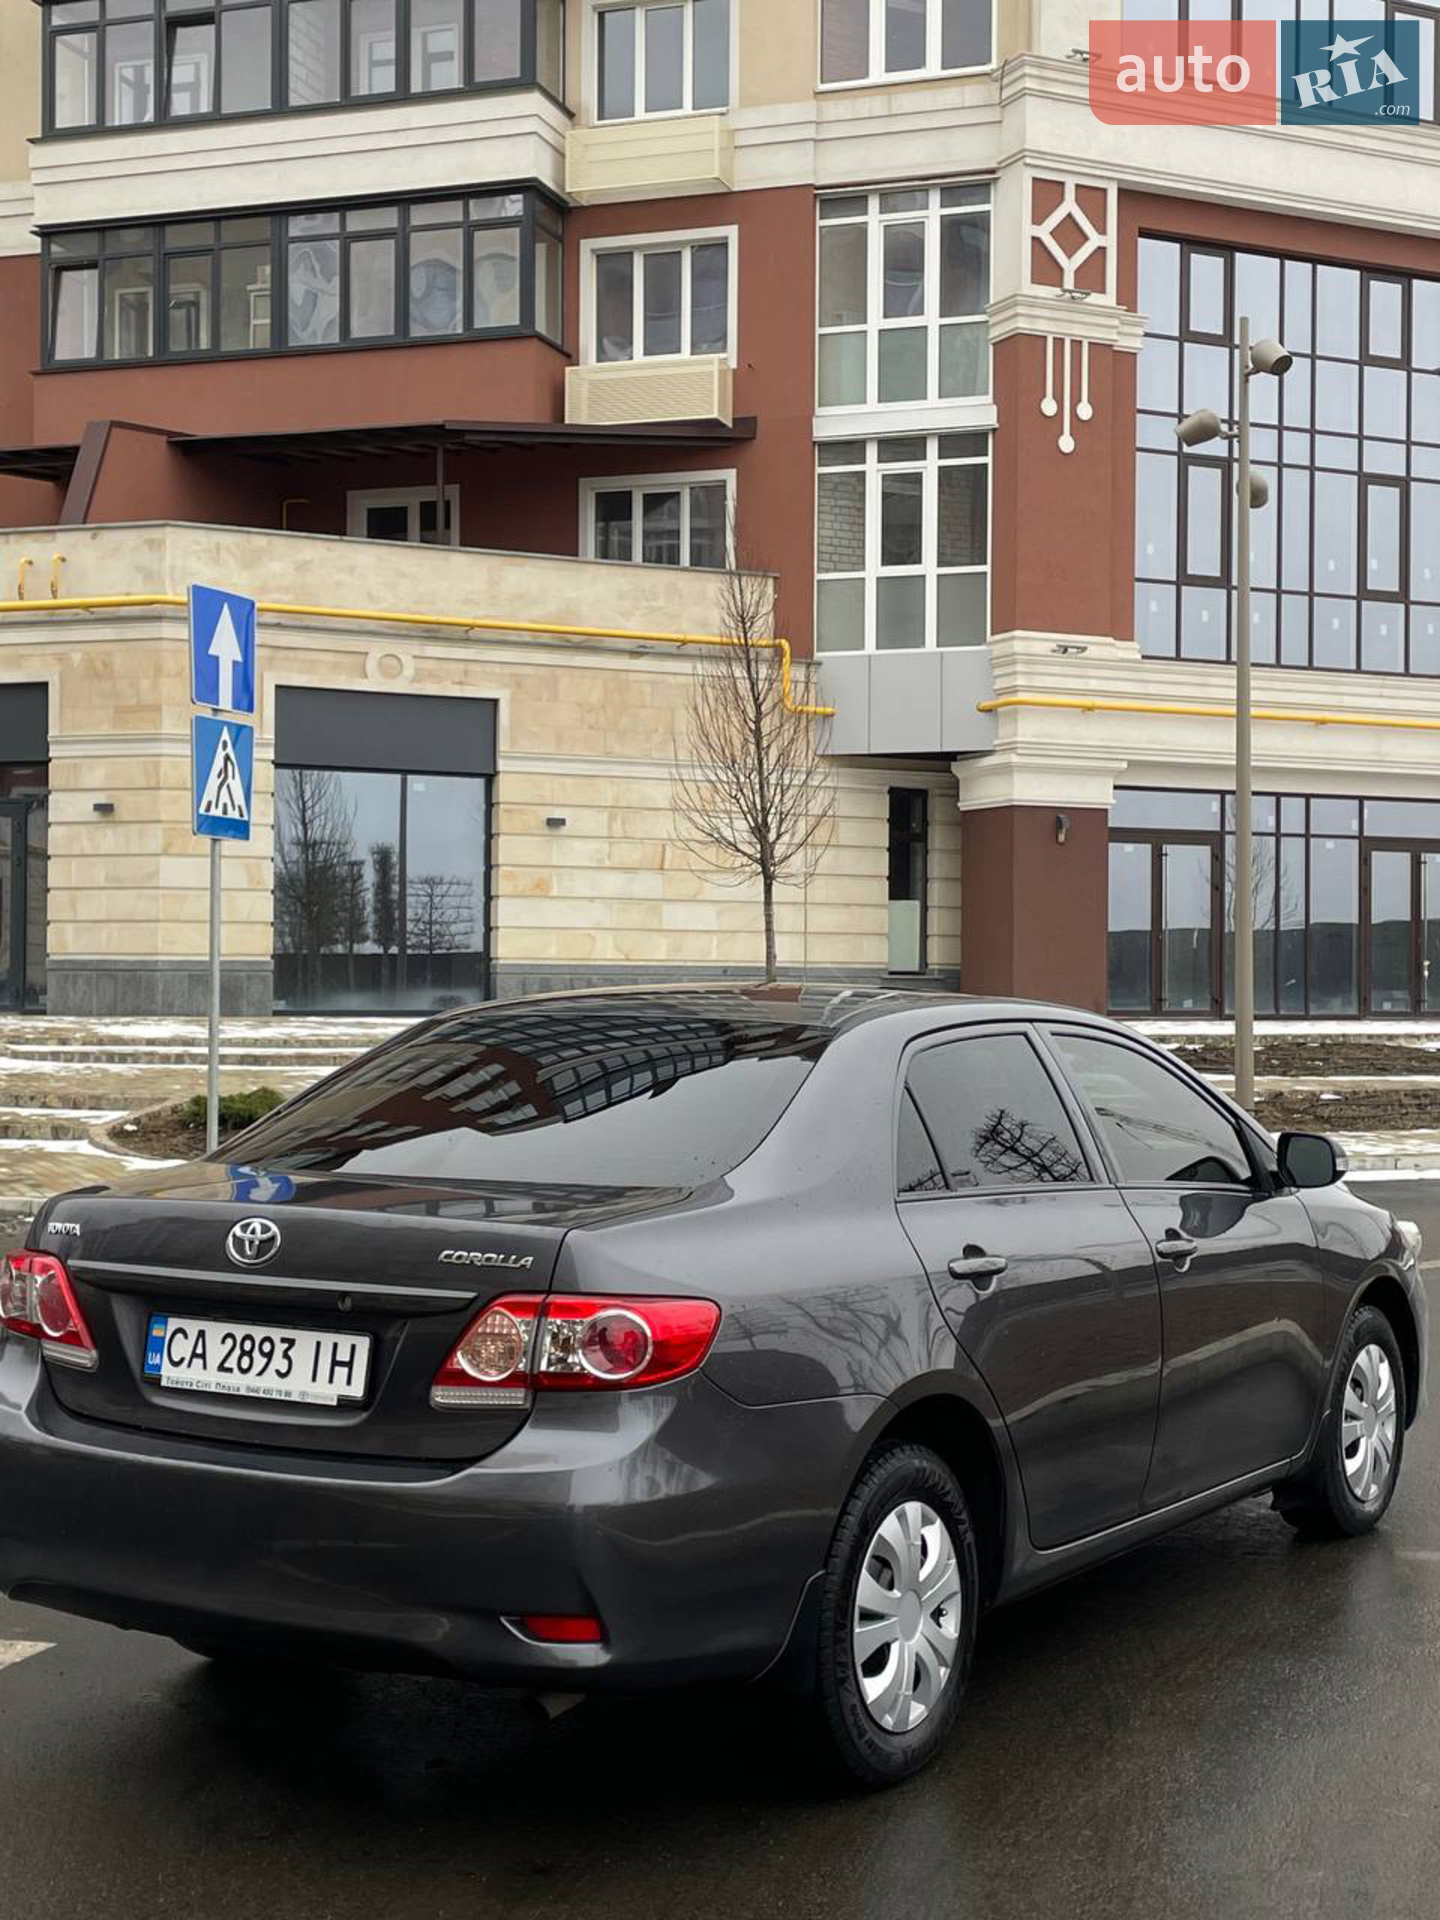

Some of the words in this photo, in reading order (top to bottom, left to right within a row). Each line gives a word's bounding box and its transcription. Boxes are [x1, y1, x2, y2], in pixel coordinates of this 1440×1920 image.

[437, 1250, 534, 1269] COROLLA
[148, 1352, 161, 1365] UA
[167, 1327, 208, 1370] CA
[217, 1332, 296, 1379] 2893
[311, 1340, 357, 1386] IH
